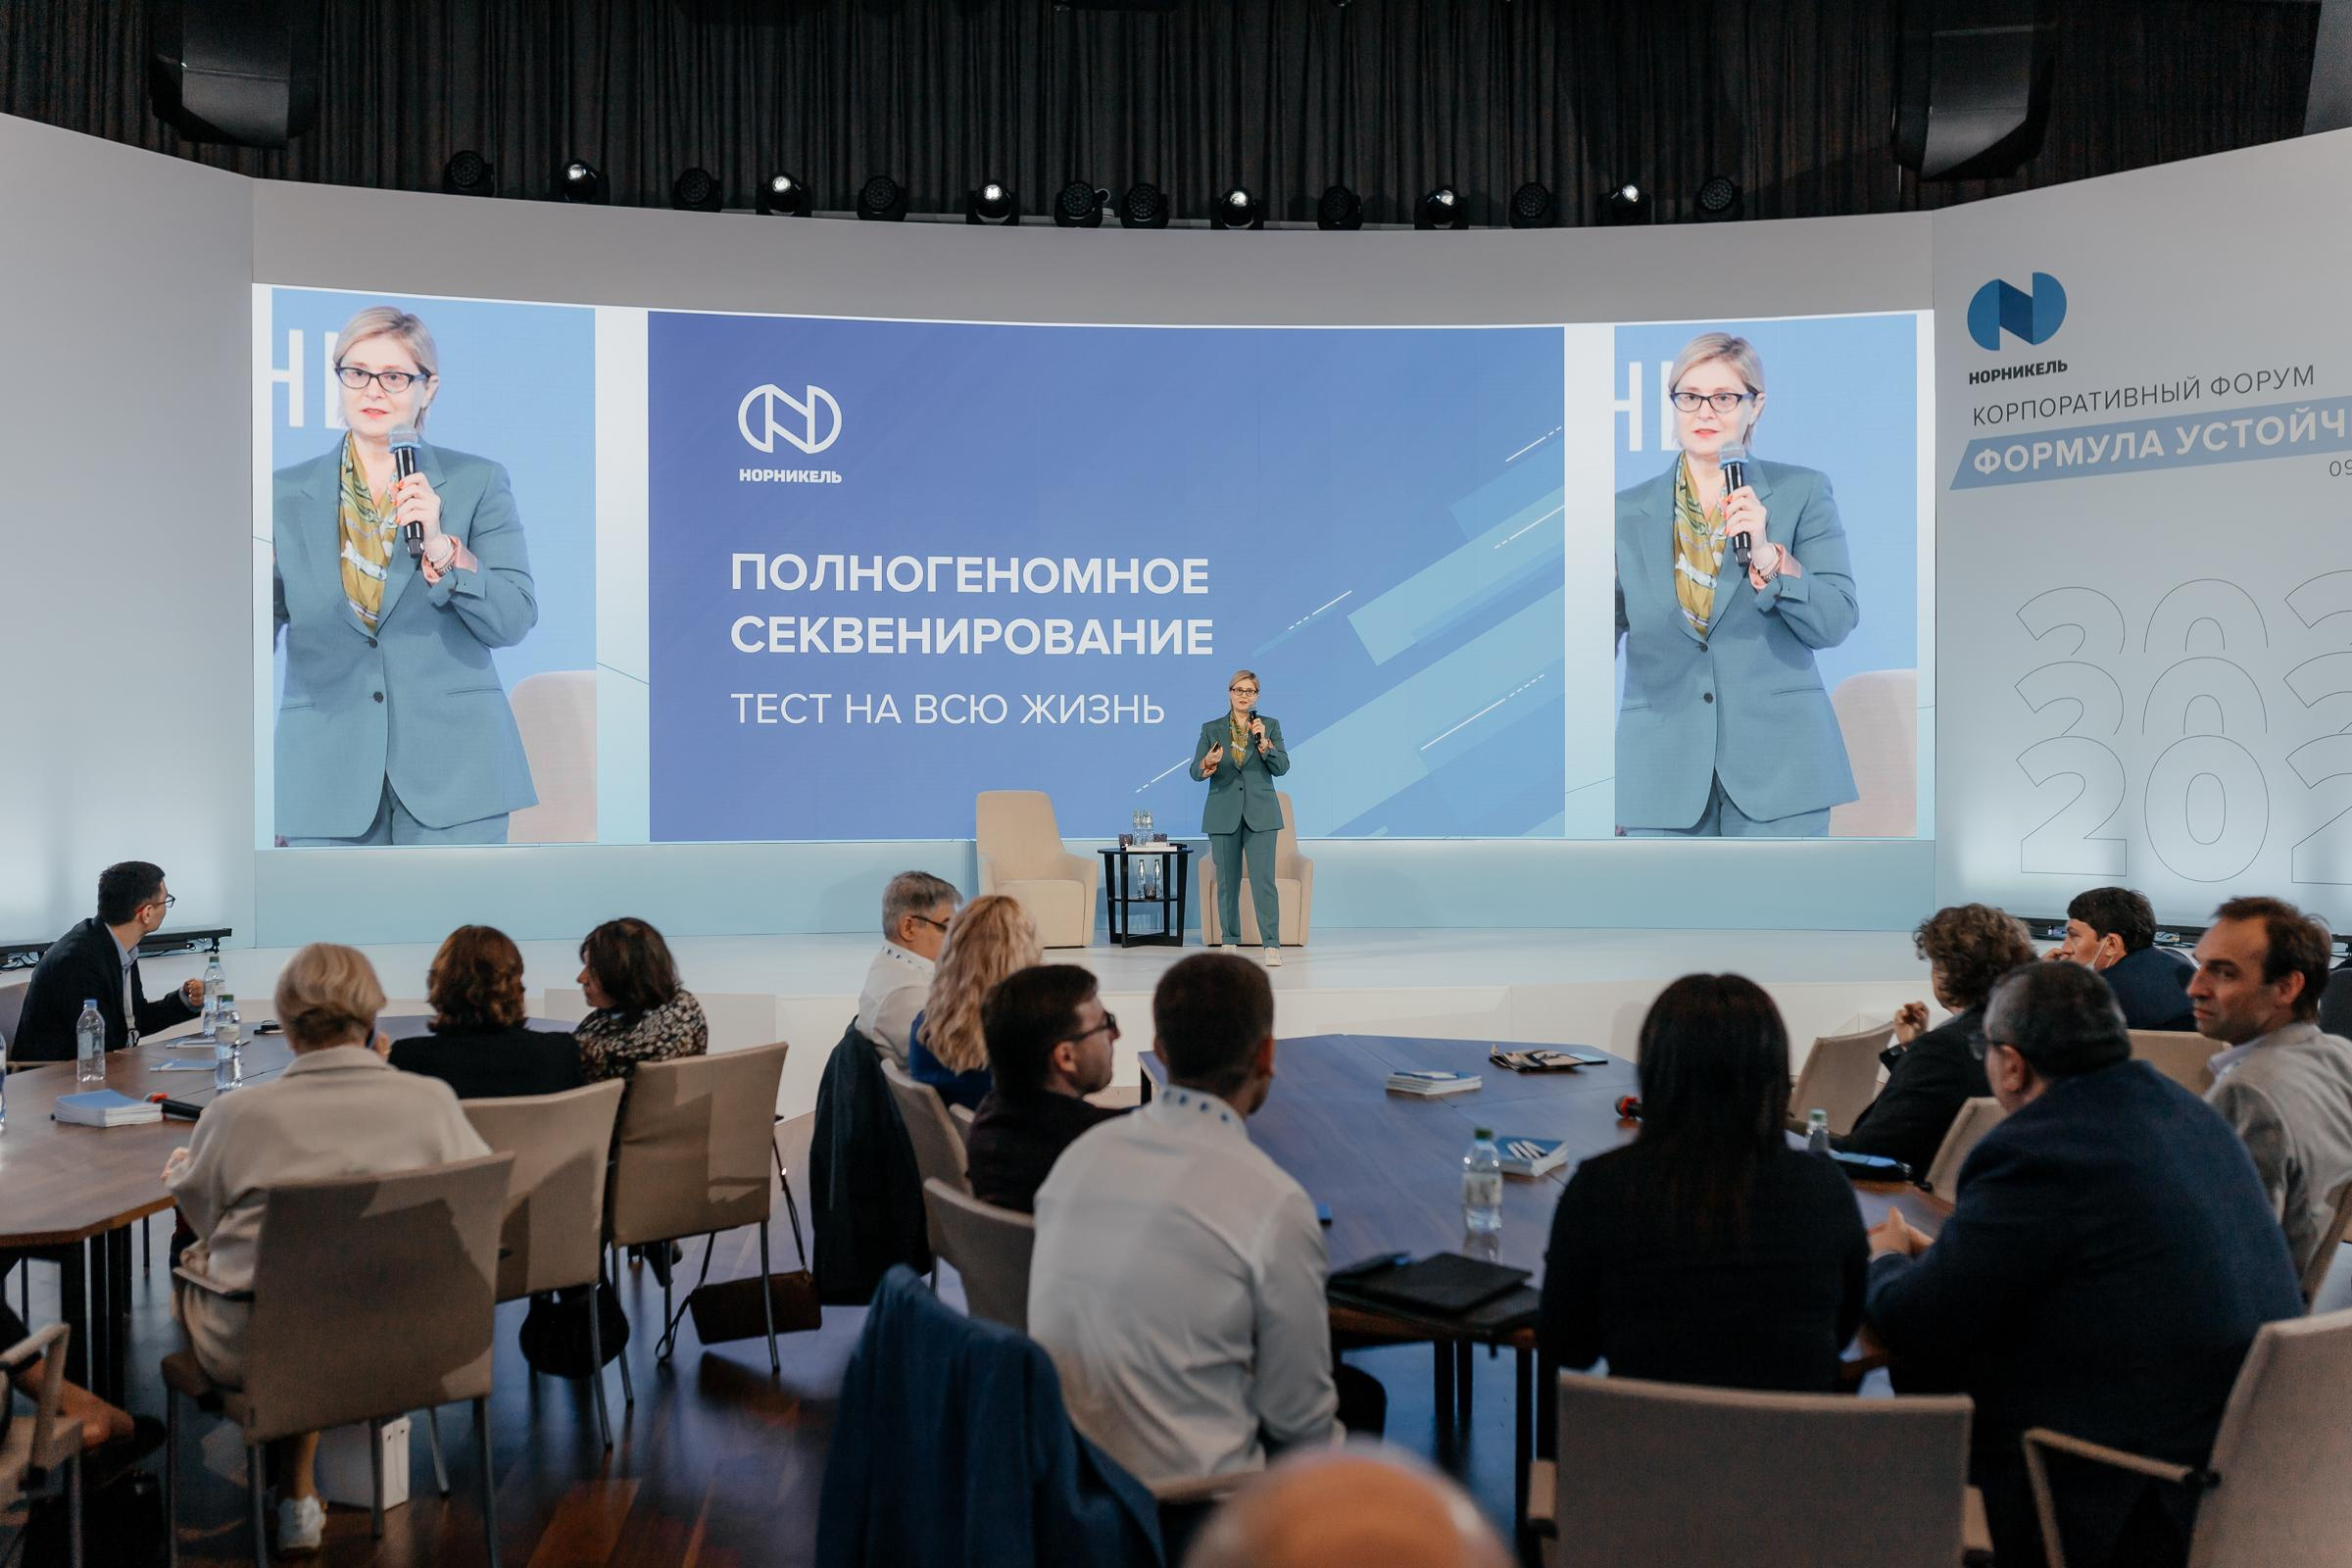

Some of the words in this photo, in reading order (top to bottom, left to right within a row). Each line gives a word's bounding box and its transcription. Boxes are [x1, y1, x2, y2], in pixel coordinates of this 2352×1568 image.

[1968, 359, 2069, 385] НОРНИКЕЛЬ
[1972, 375, 2201, 426] КОРПОРАТИВНЫЙ
[2209, 364, 2315, 398] ФОРУМ
[1973, 428, 2165, 475] ФОРМУЛА
[2175, 405, 2352, 456] УСТОЙЧ
[739, 468, 843, 484] НОРНИКЕЛЬ
[731, 553, 1209, 595] ПОЛНОГЕНОМНОЕ
[730, 615, 1214, 656] СЕКВЕНИРОВАНИЕ
[730, 693, 832, 724] ТЕСТ
[846, 694, 903, 724] НА
[914, 693, 1008, 724] ВСЮ
[1020, 694, 1165, 724] ЖИЗНЬ
